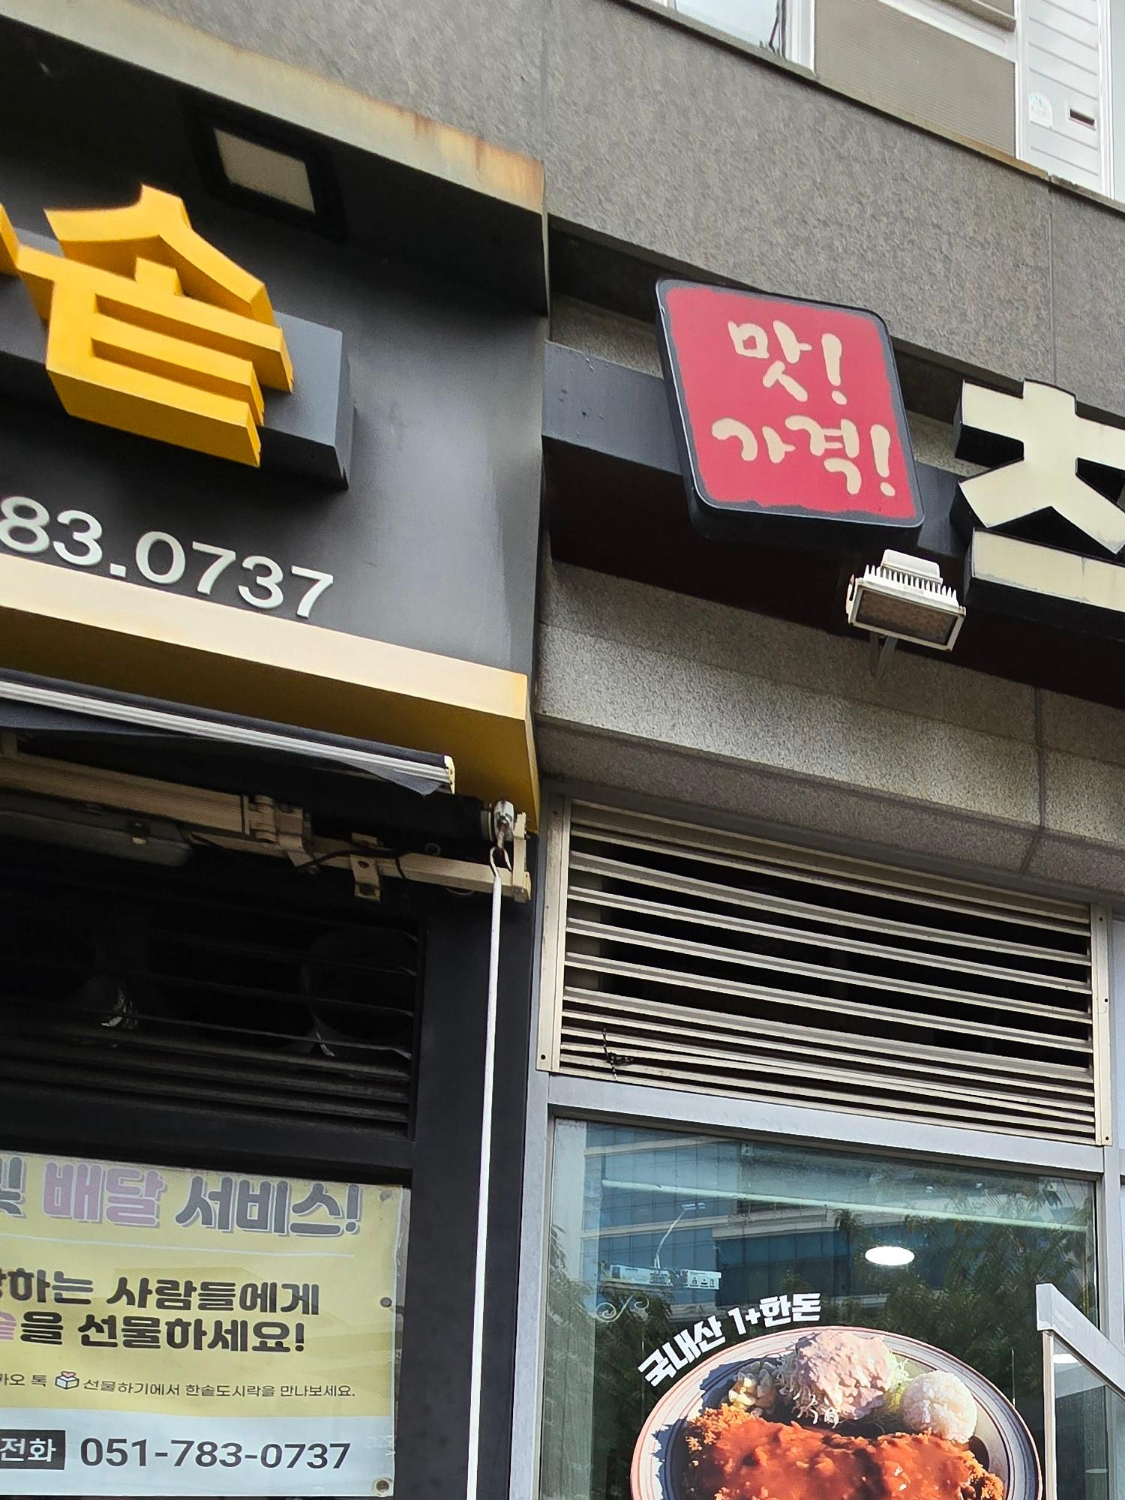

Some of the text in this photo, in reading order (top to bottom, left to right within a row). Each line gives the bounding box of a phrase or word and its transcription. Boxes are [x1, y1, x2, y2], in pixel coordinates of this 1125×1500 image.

[0, 184, 294, 468] 솥
[727, 320, 848, 406] 맛!
[711, 414, 896, 497] 가격!
[0, 496, 334, 619] 83.0737
[42, 1161, 167, 1226] 배달
[174, 1175, 362, 1237] 서비스!
[0, 1267, 320, 1315] 하는 사람들에게
[77, 1313, 306, 1353] 선물하세요!
[637, 1293, 822, 1388] 국내산 1+한돈
[83, 1379, 181, 1397] 선물하기에서
[185, 1382, 276, 1398] 한솥도시락을
[279, 1384, 356, 1398] 만나보세요.
[0, 1437, 351, 1470] 전화 051-783-0737
